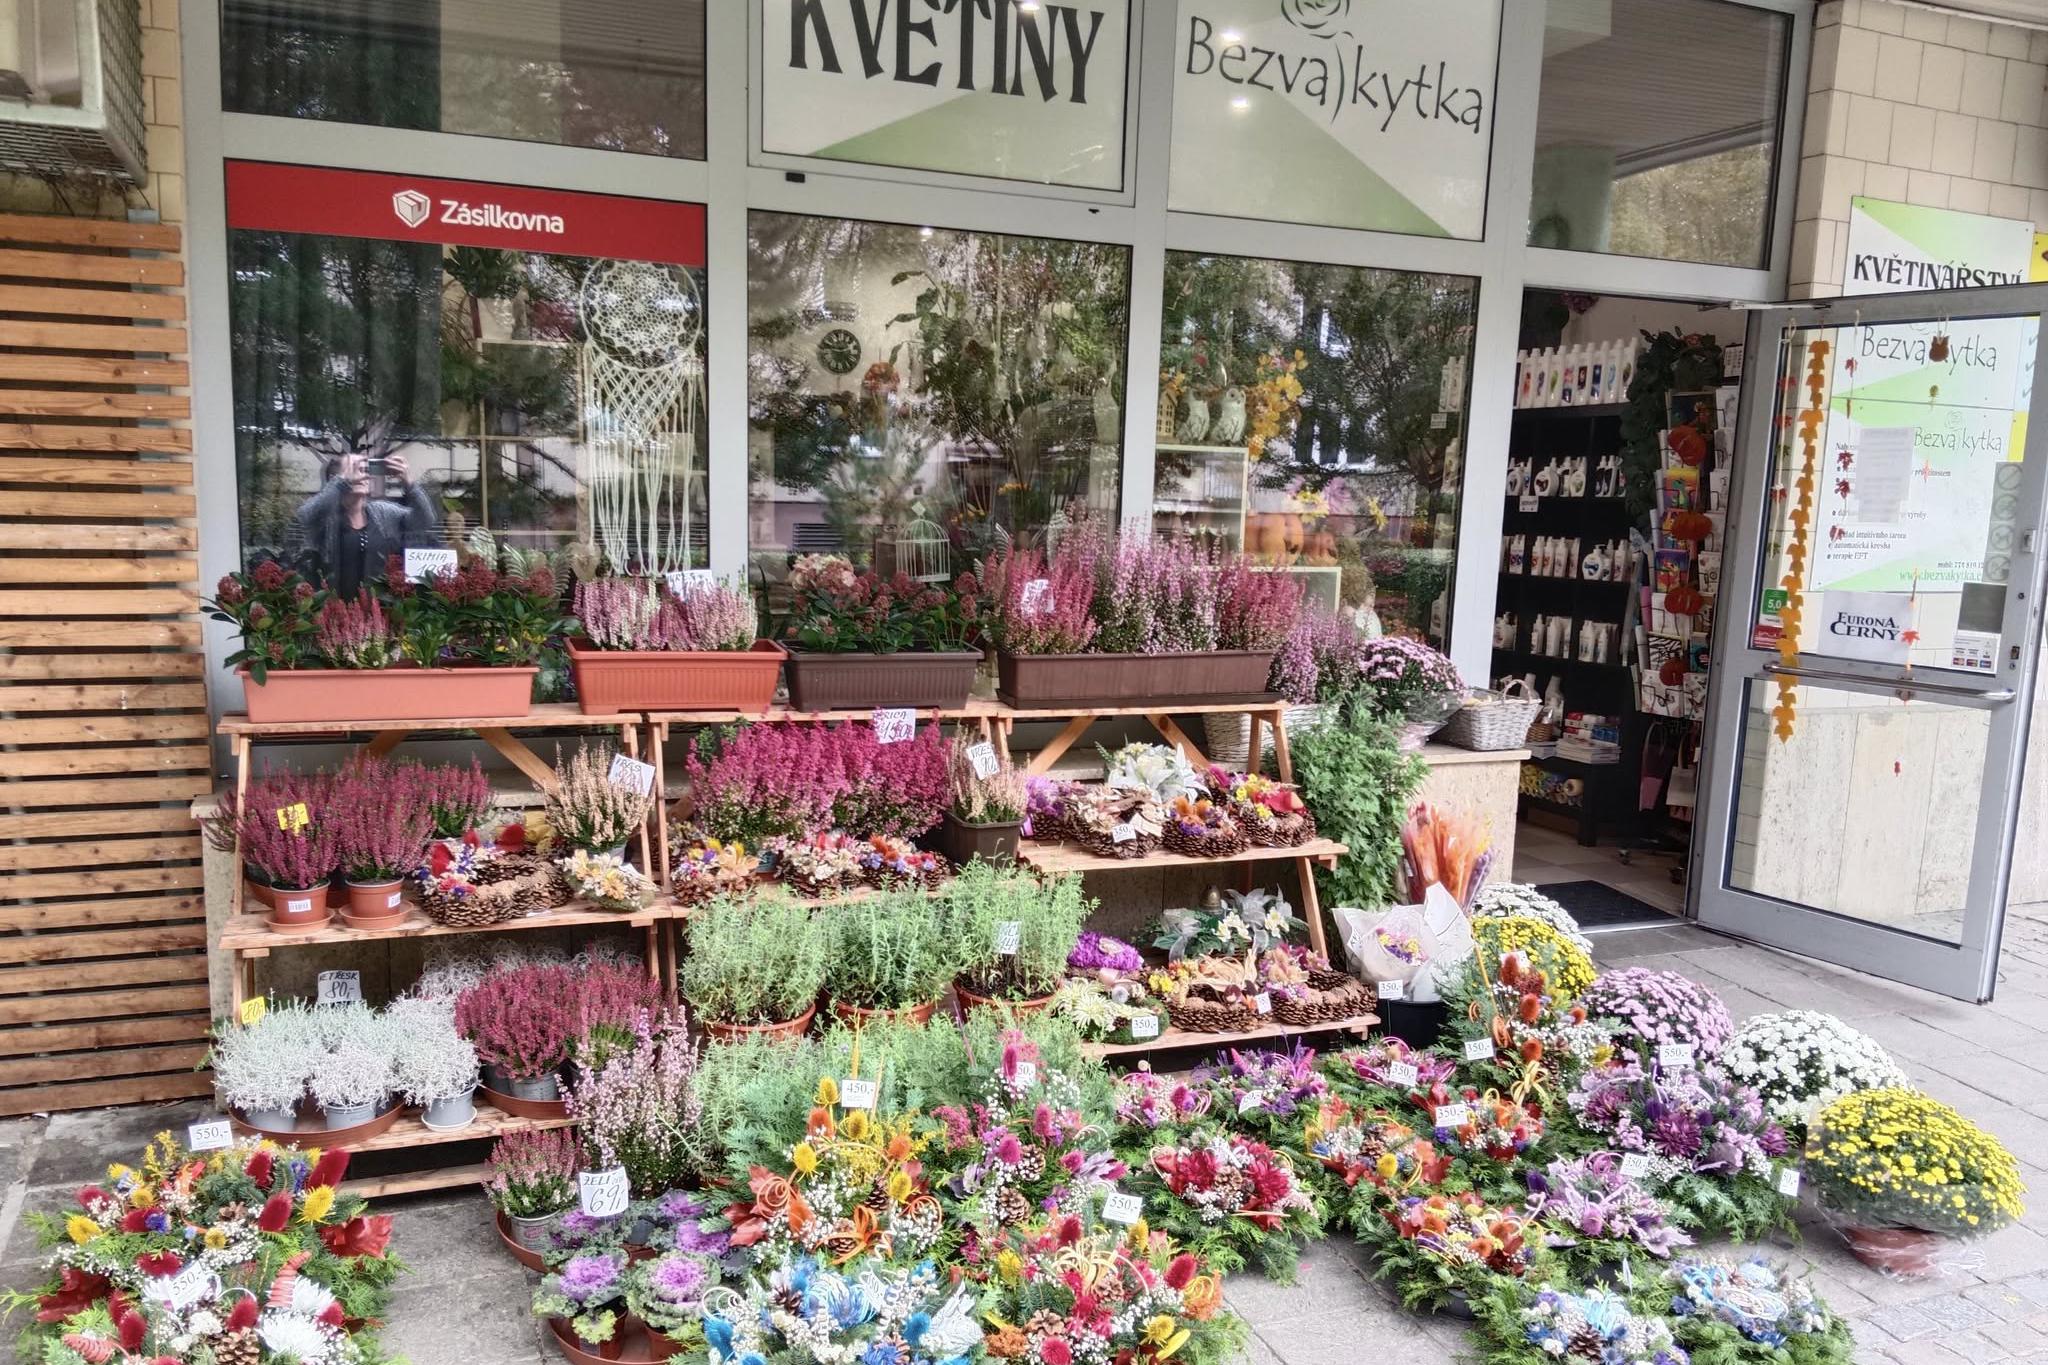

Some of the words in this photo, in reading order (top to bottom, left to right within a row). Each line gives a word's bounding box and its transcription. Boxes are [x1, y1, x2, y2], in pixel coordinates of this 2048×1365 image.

[1351, 44, 1483, 135] kytka
[440, 200, 565, 234] Zásilkovna
[1942, 334, 1998, 376] ytka
[1961, 427, 2003, 457] kytka
[1854, 552, 1869, 560] EFT
[1768, 599, 1782, 611] 5,0
[1838, 611, 1897, 629] EURONA
[1830, 620, 1901, 640] CERNY
[883, 711, 907, 720] RICA
[325, 980, 355, 999] 80,-
[1381, 982, 1402, 992] 350,-
[1133, 1018, 1157, 1030] 350,-
[1467, 1041, 1490, 1053] 350,-
[1663, 1047, 1689, 1058] 550,-
[1018, 1065, 1034, 1076] 50,-
[1391, 1063, 1415, 1077] 350,-
[846, 1082, 874, 1095] 450,-
[1438, 1106, 1464, 1118] 350,-
[195, 1126, 229, 1141] 550,-
[1109, 1197, 1138, 1211] 550,-
[172, 1271, 202, 1296] 550,-
